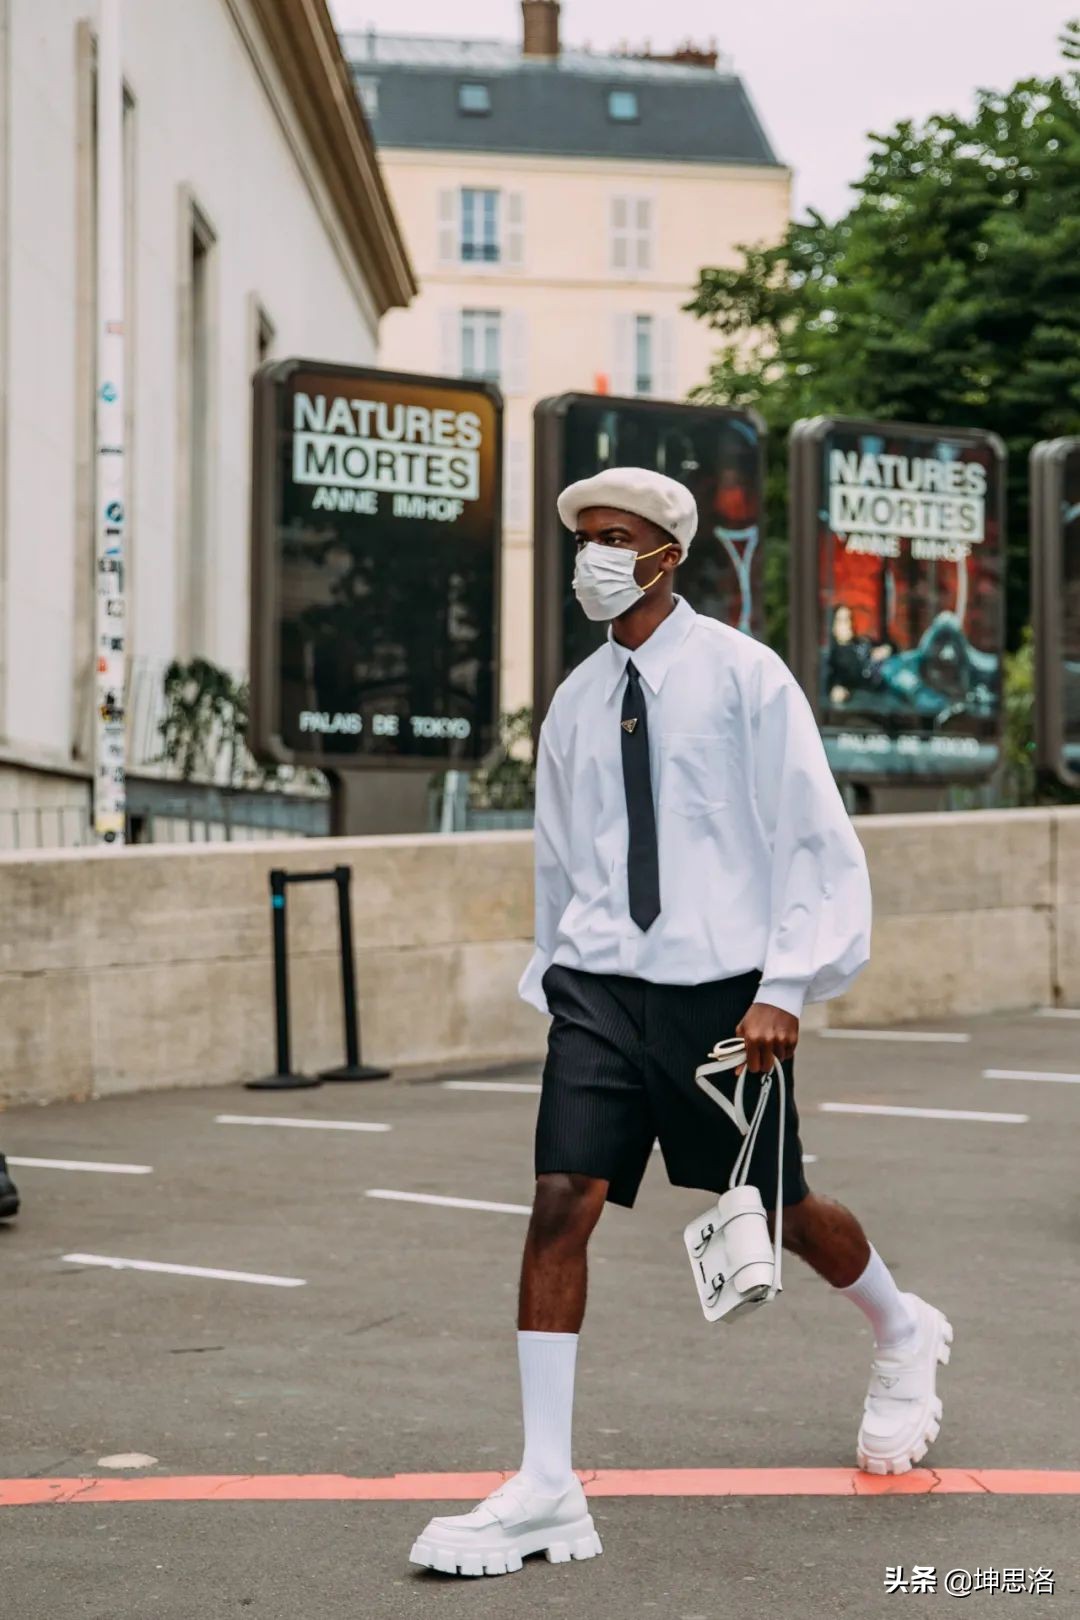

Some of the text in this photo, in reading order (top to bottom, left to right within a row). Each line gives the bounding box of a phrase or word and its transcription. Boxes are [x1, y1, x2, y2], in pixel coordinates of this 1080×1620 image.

[294, 392, 482, 448] NATURES
[304, 443, 470, 489] MORTES
[829, 449, 987, 495] NATURES
[312, 486, 464, 522] ANNE IMHOF
[838, 494, 977, 533] MORTES
[299, 711, 470, 739] PALAIS DE TOKYO
